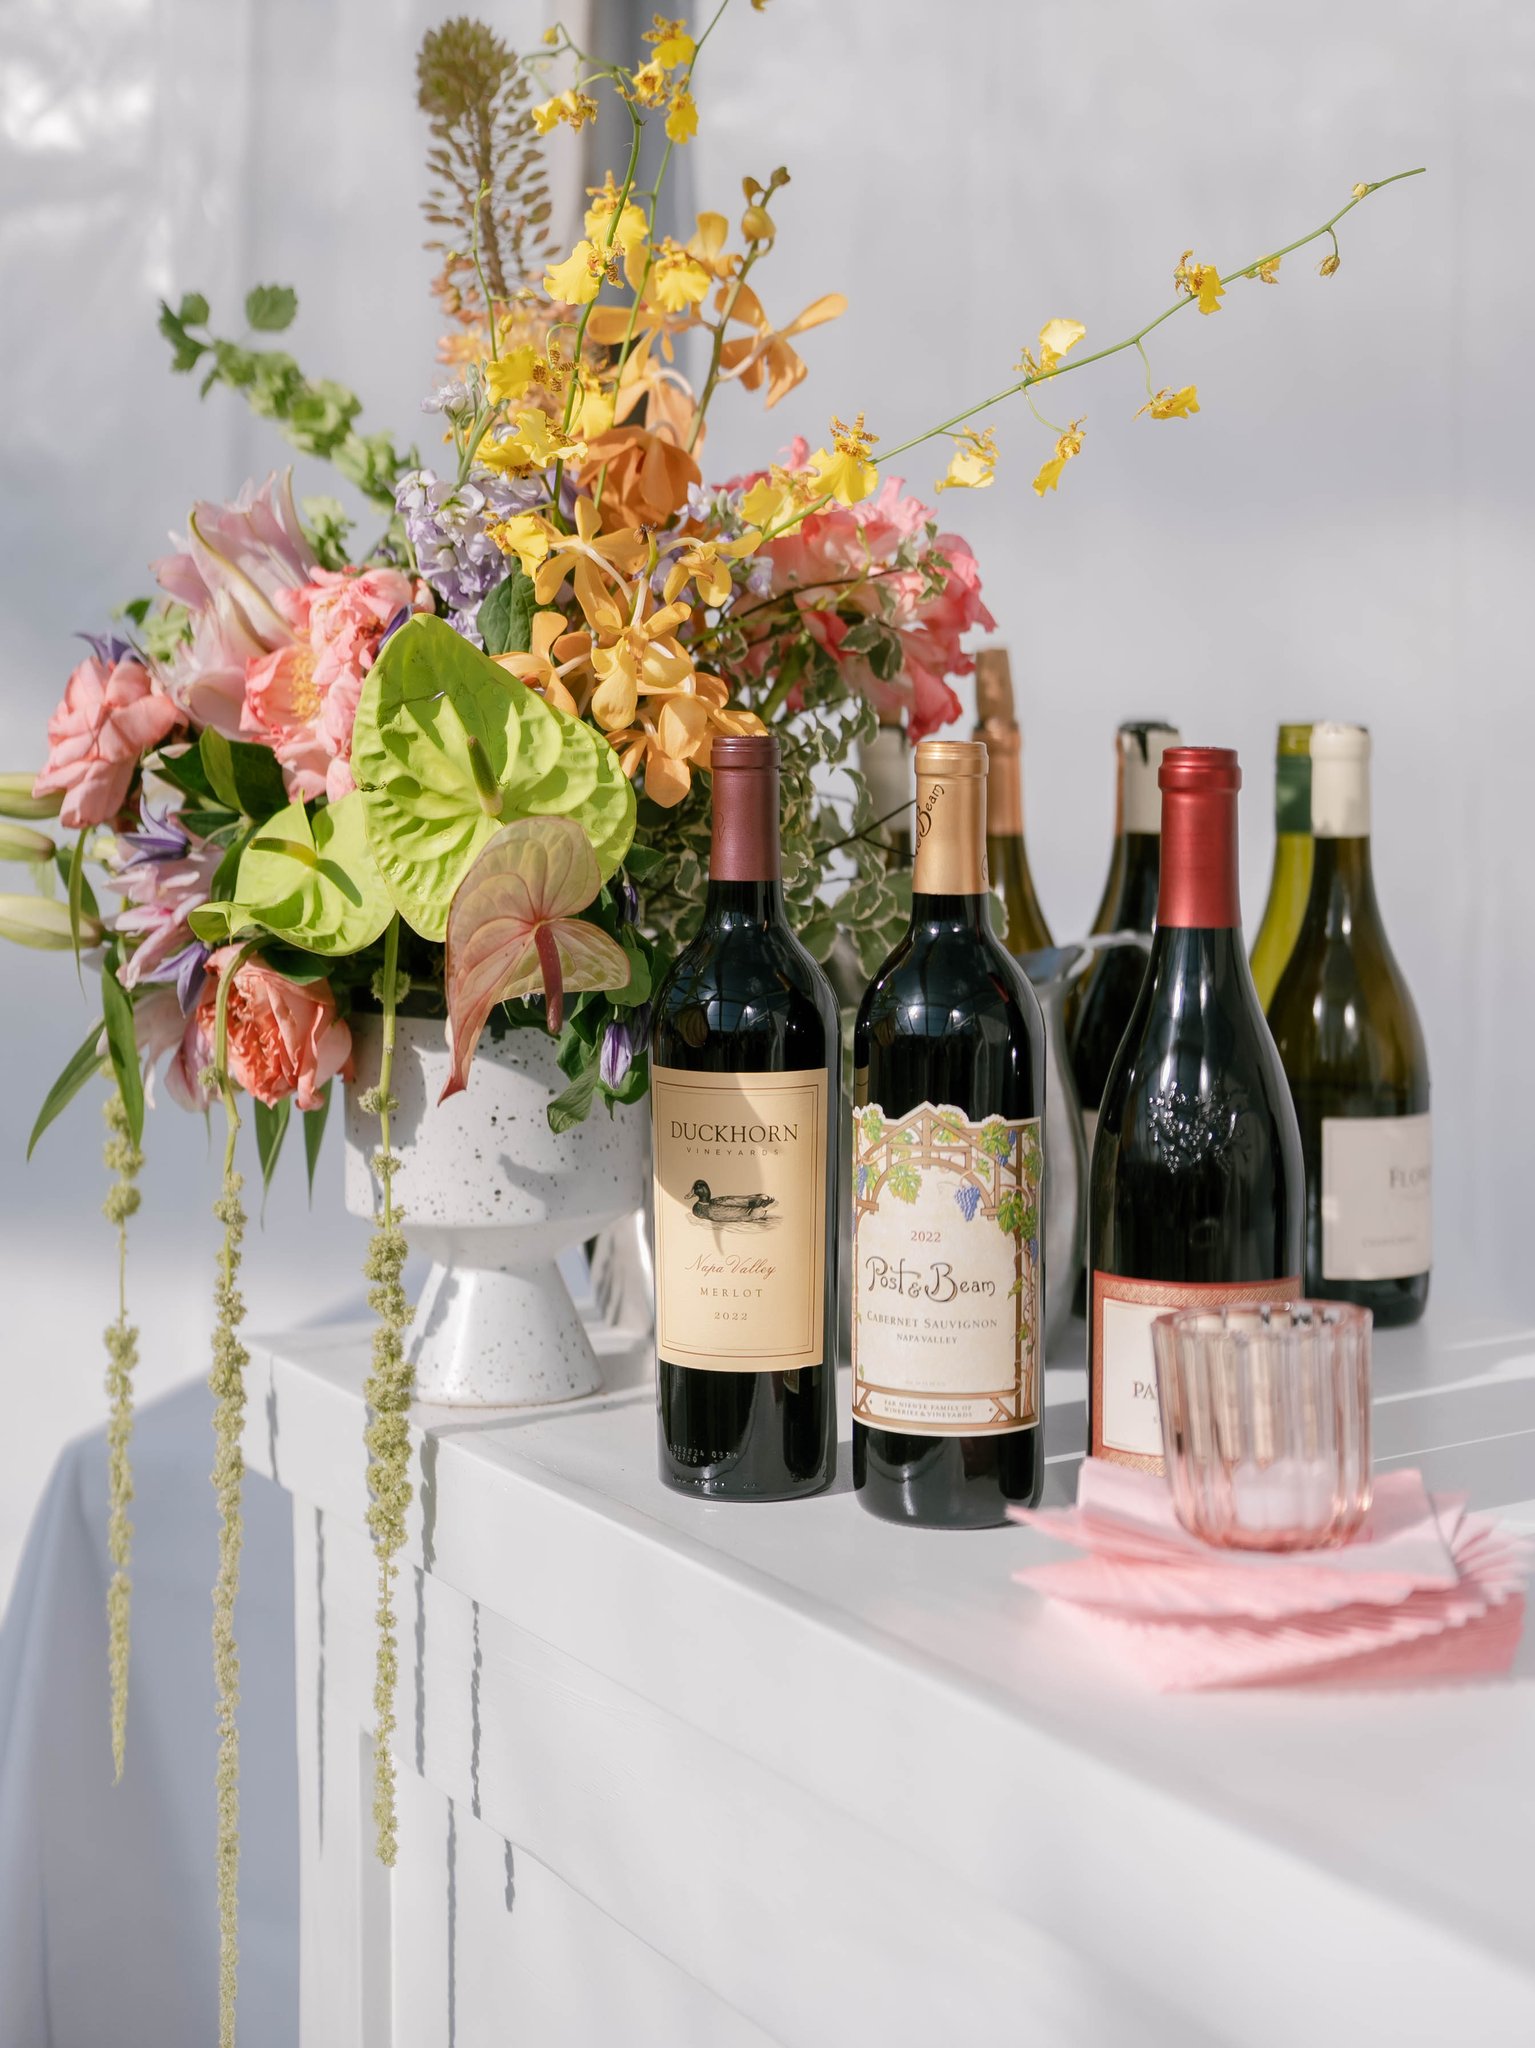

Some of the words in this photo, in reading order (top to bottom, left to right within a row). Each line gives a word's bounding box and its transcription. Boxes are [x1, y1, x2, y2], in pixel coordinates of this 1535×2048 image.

[671, 1121, 798, 1143] DUCKHORN
[686, 1147, 779, 1156] VINEYARDS
[910, 1230, 942, 1243] 2022
[684, 1254, 724, 1276] Napa
[725, 1254, 776, 1280] Valley
[866, 1256, 922, 1294] Post
[908, 1281, 922, 1299] &
[925, 1262, 996, 1303] Beam
[700, 1286, 763, 1298] MERLOT
[714, 1311, 748, 1321] 2022
[867, 1310, 918, 1328] CABERNET
[924, 1318, 997, 1330] SAUVIGNON
[896, 1333, 921, 1343] NAPA
[922, 1335, 958, 1345] VALLEY
[1133, 1381, 1158, 1400] PA
